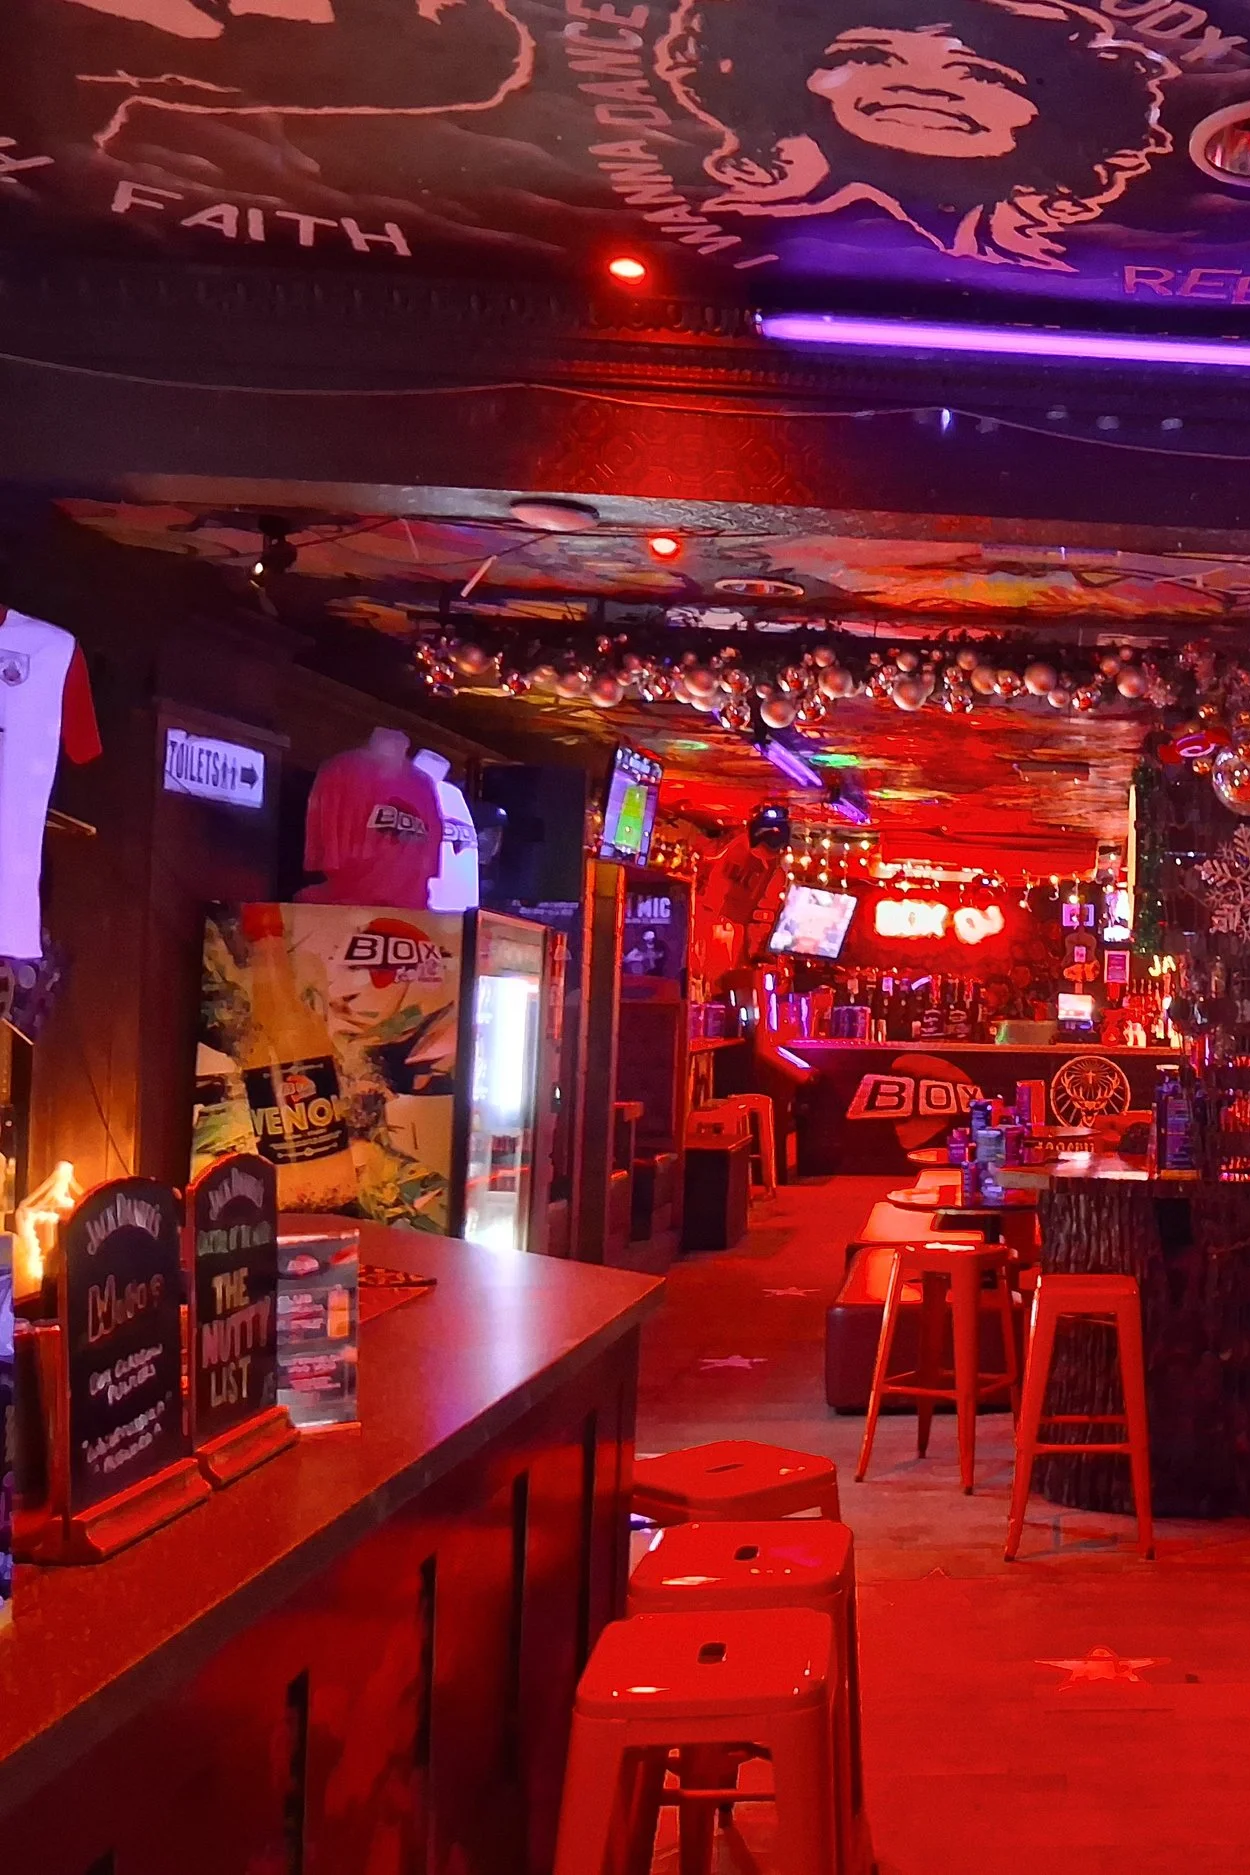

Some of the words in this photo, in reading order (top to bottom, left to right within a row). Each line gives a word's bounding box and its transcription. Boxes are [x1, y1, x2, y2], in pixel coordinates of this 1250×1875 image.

[563, 0, 673, 127] DANCE
[110, 179, 413, 257] FAITH
[588, 138, 742, 255] WANNA
[167, 739, 219, 788] TOILETS
[636, 894, 671, 918] MIC
[343, 934, 442, 962] BOX
[212, 1267, 250, 1315] THE
[201, 1296, 272, 1369] NUTTY
[210, 1355, 250, 1408] LIST
